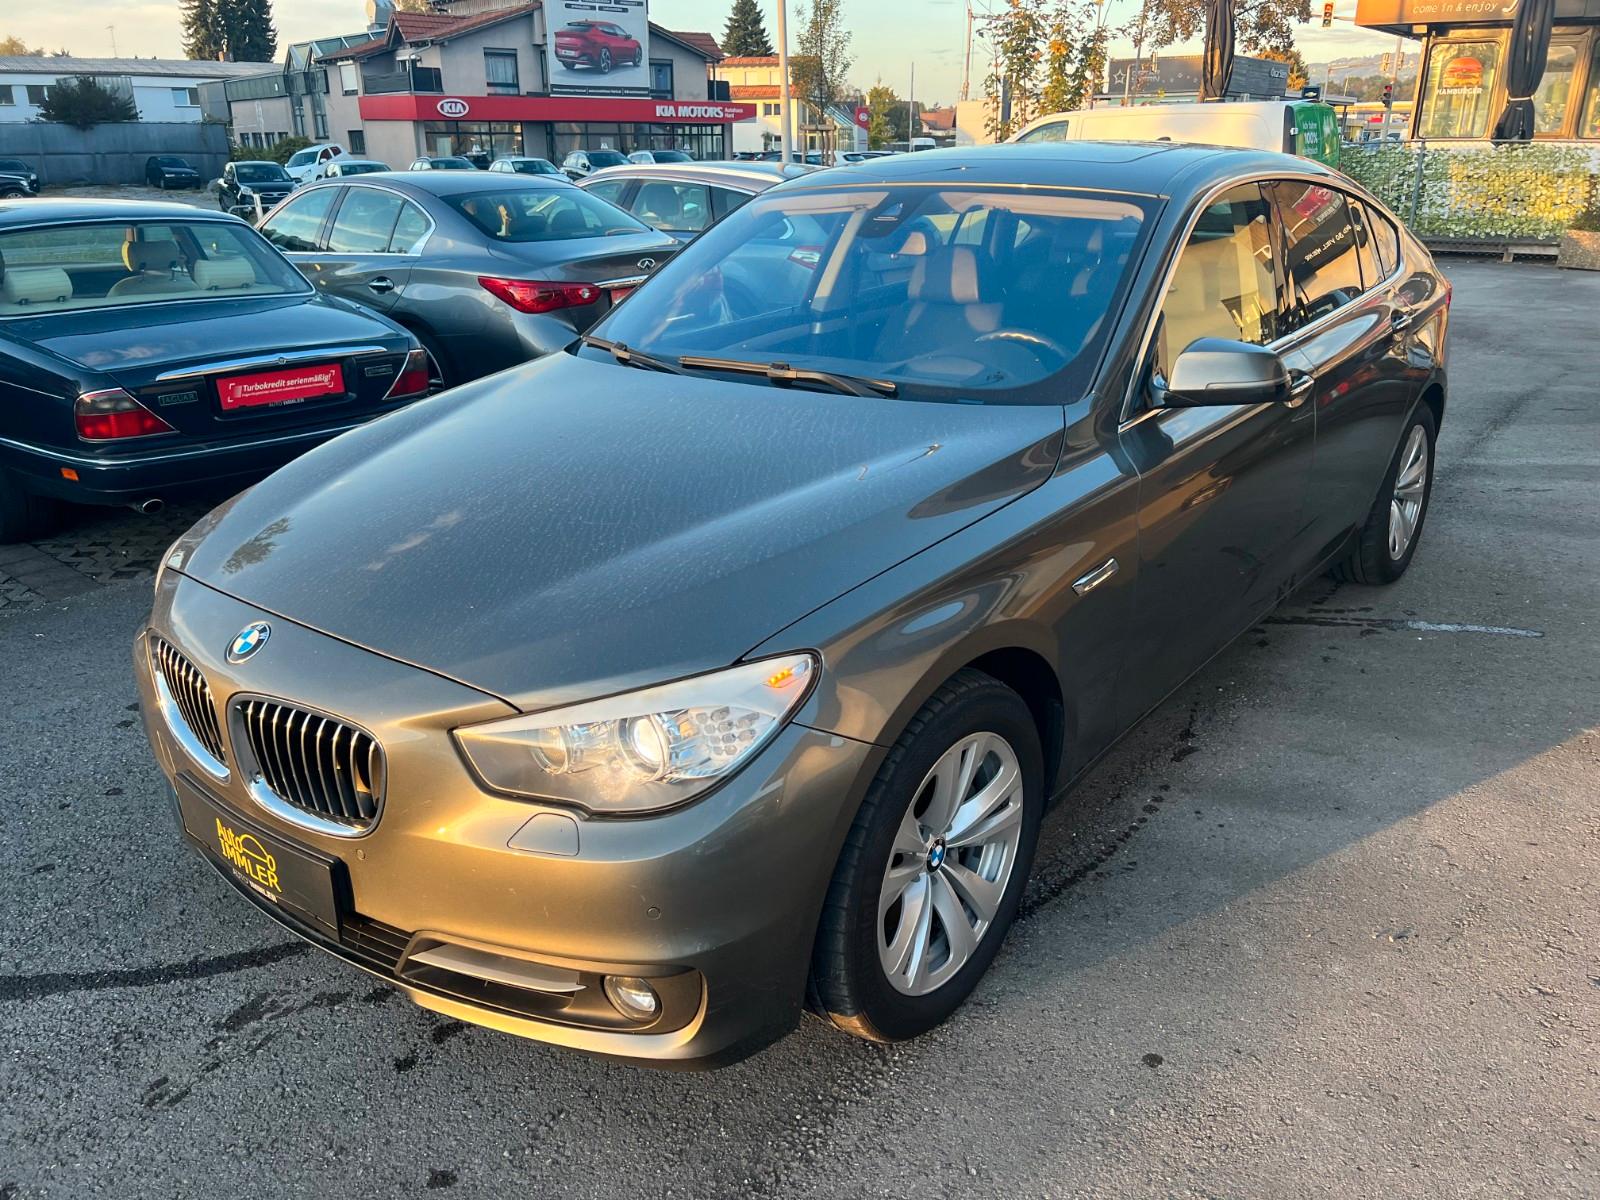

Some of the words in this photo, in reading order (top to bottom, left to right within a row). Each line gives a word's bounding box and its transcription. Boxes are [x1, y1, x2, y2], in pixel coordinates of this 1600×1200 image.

[1412, 4, 1437, 14] come
[1441, 4, 1453, 12] in
[1456, 3, 1463, 12] &
[1465, 2, 1498, 13] enjoy
[1437, 87, 1482, 95] HAMBURGER
[655, 105, 676, 117] KIA
[678, 106, 724, 118] MOTORS
[243, 378, 286, 392] Turbokredit
[286, 373, 332, 387] serienmäßig!
[219, 837, 282, 893] IMMLER
